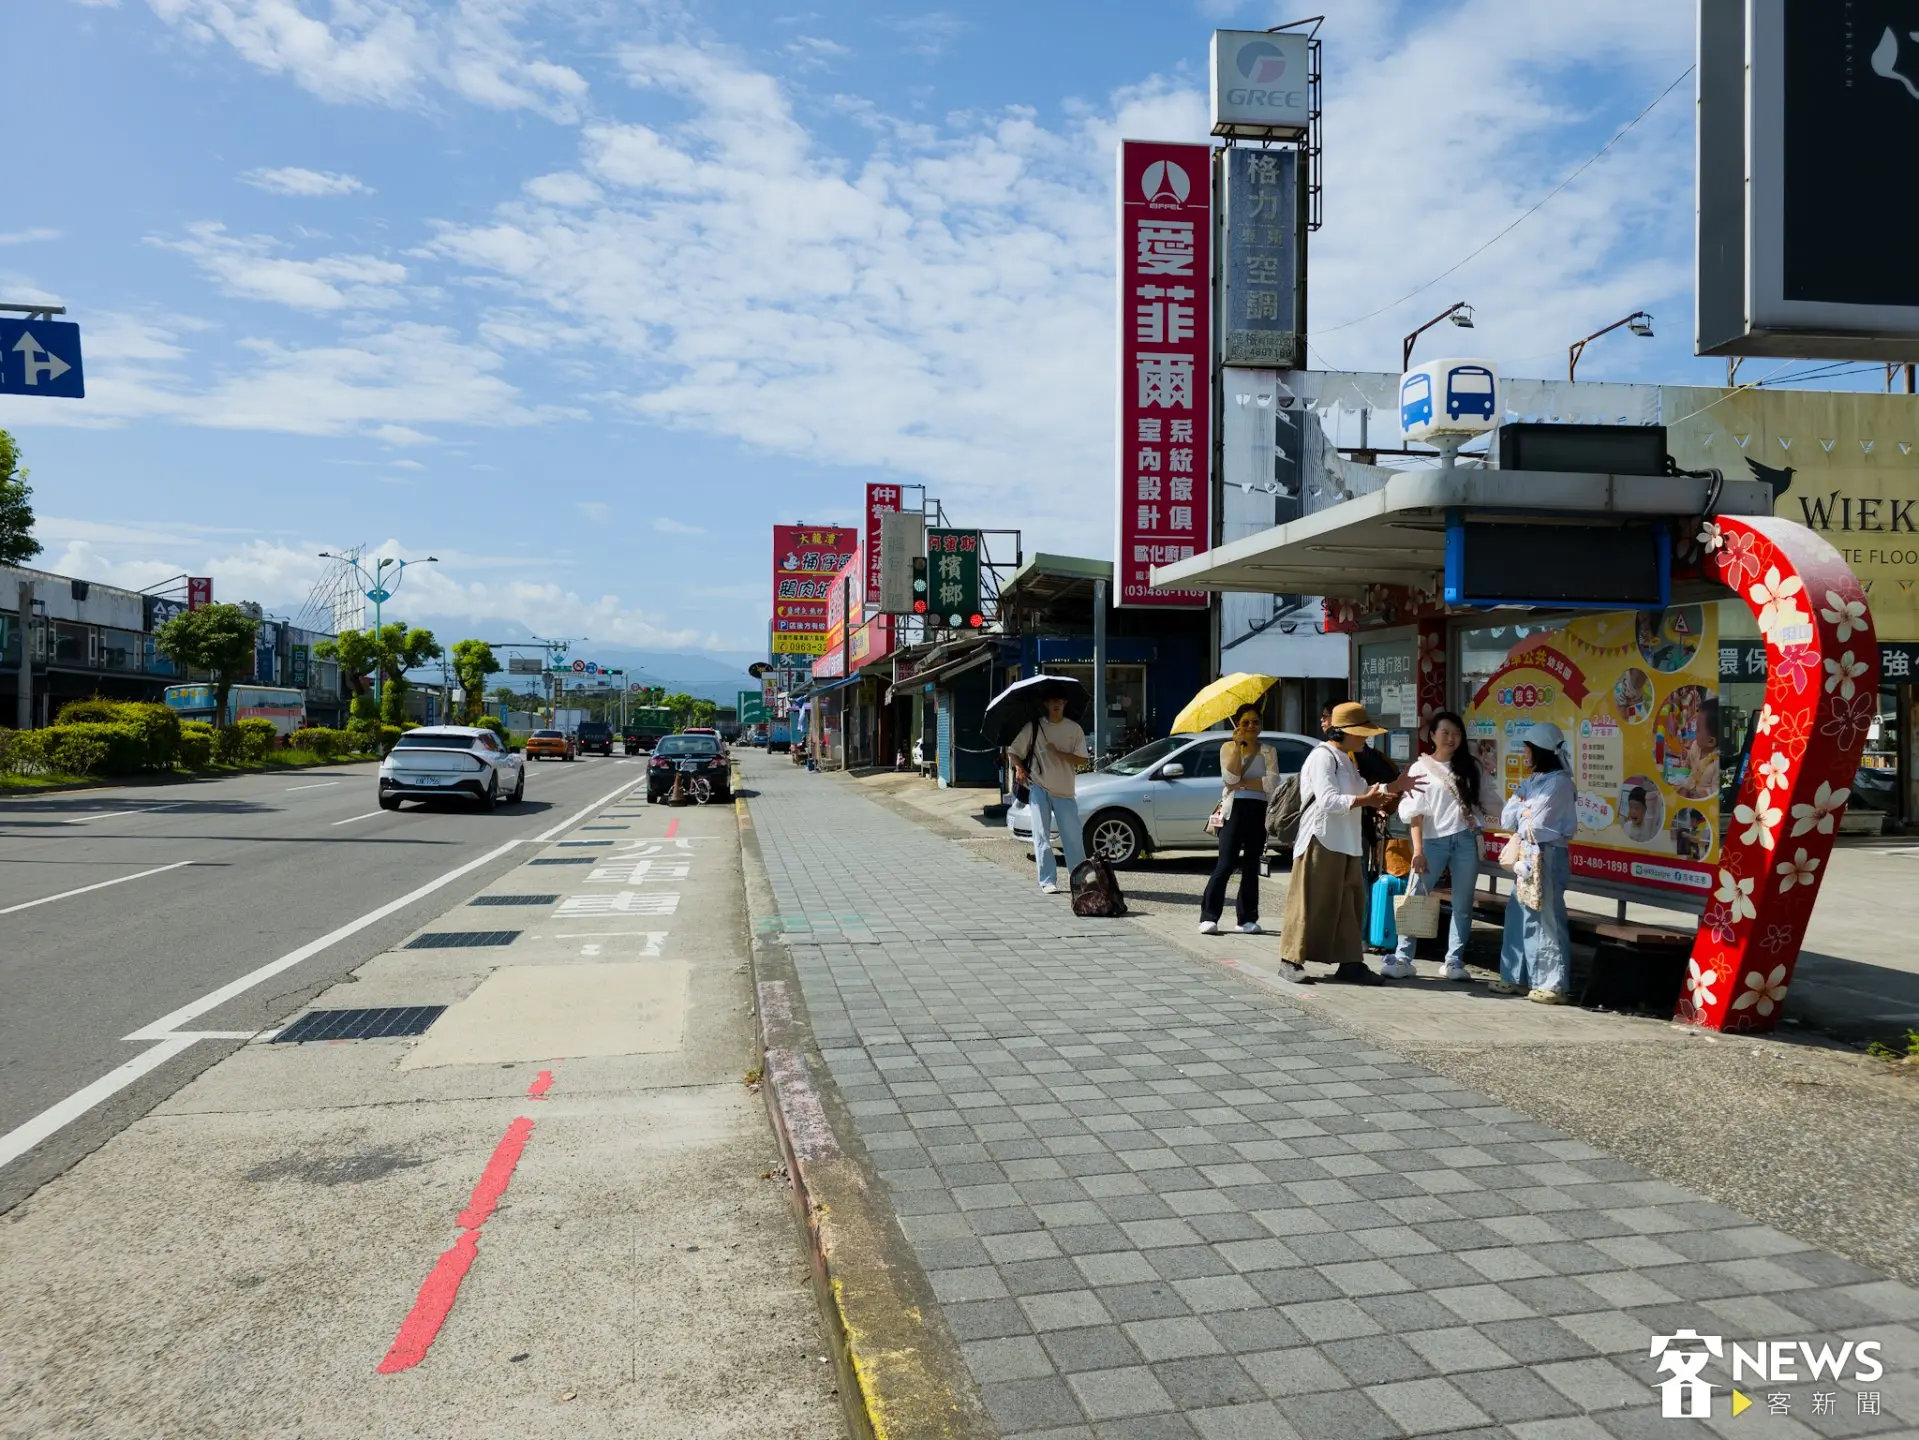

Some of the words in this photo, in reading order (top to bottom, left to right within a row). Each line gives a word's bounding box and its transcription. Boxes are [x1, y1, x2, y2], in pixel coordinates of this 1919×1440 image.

[1226, 88, 1304, 109] GREE
[1149, 203, 1184, 211] EIFFEL
[1136, 219, 1195, 409] 愛菲爾
[1137, 418, 1162, 530] 室內設計
[1169, 419, 1194, 530] 系統傢俱
[1798, 490, 1919, 532] WIEK
[928, 535, 977, 552] 阿蜜斯
[939, 554, 963, 607] 檳榔
[1573, 855, 1628, 874] 03-480-1898
